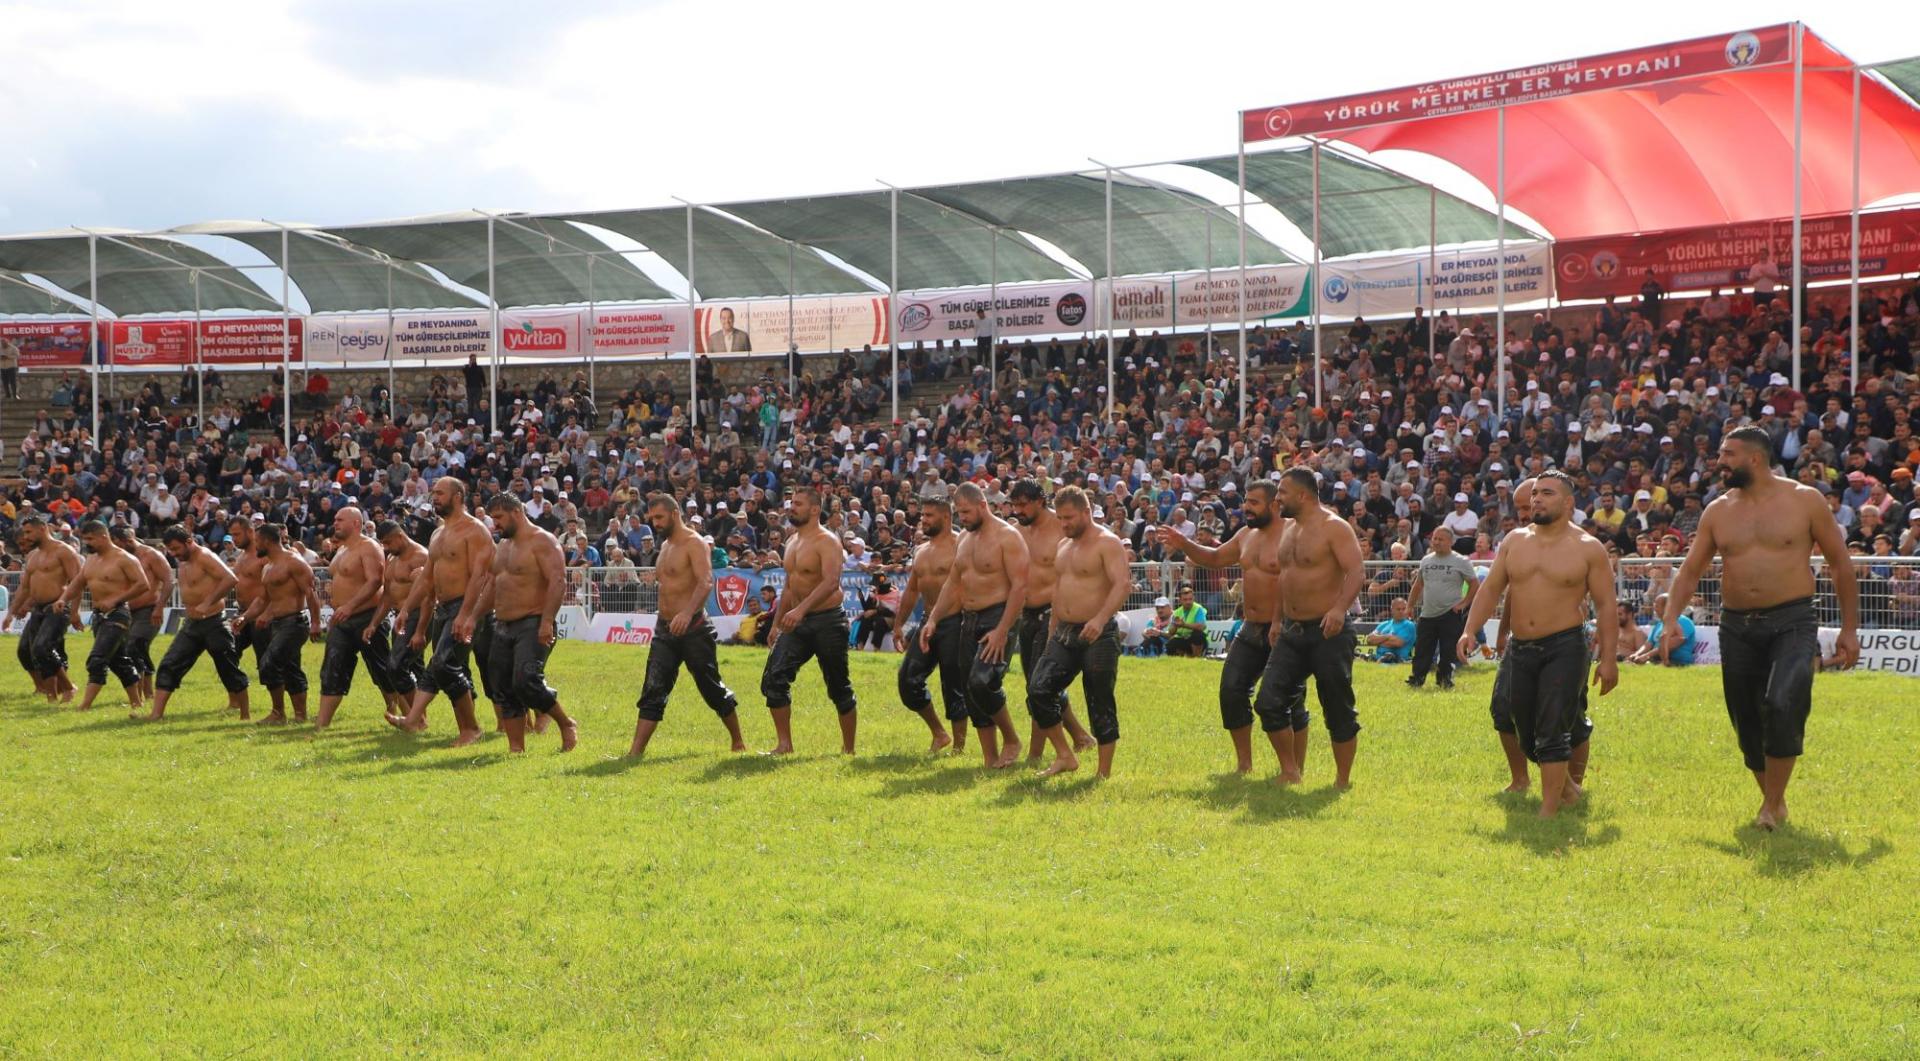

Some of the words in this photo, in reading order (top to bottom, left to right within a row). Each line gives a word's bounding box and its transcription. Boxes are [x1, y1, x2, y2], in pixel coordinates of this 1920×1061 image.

[1418, 86, 1438, 94] T.C.
[1440, 74, 1504, 91] TURGUTLU
[1506, 60, 1578, 80] BELEDİYESİ
[1324, 101, 1401, 122] YÖRÜK
[1411, 82, 1510, 111] MEHMET
[1521, 76, 1552, 93] ER
[1563, 54, 1683, 86] MEYDANI
[1666, 241, 1717, 261] YÖRÜK
[1721, 237, 1787, 257] MEHMT
[1441, 261, 1455, 271] ER
[1194, 281, 1207, 291] ER
[1210, 275, 1278, 290] MEYDNINDA
[1425, 273, 1449, 286] TÜM
[1434, 285, 1495, 300] BAŞARILAR
[940, 301, 961, 314] TÜM
[1246, 300, 1288, 313] DİLERİZ
[408, 321, 419, 329] ER
[420, 319, 478, 329] MEYDANINDA
[599, 315, 610, 324] ER
[611, 313, 663, 323] MEYDANINDA
[1005, 311, 1045, 328] DİLERİZ
[3, 324, 55, 335] BELEDİYESİ
[208, 325, 222, 333] ER
[223, 323, 284, 333] MEYDANINDA
[395, 332, 414, 342] TÜM
[415, 329, 491, 342] GÜREŞÇİLERİMİZE
[509, 330, 563, 349] yurttan
[640, 336, 671, 345] DİLERİZ
[402, 345, 452, 354] BAŞARILAR
[453, 342, 487, 352] DİLERİZ
